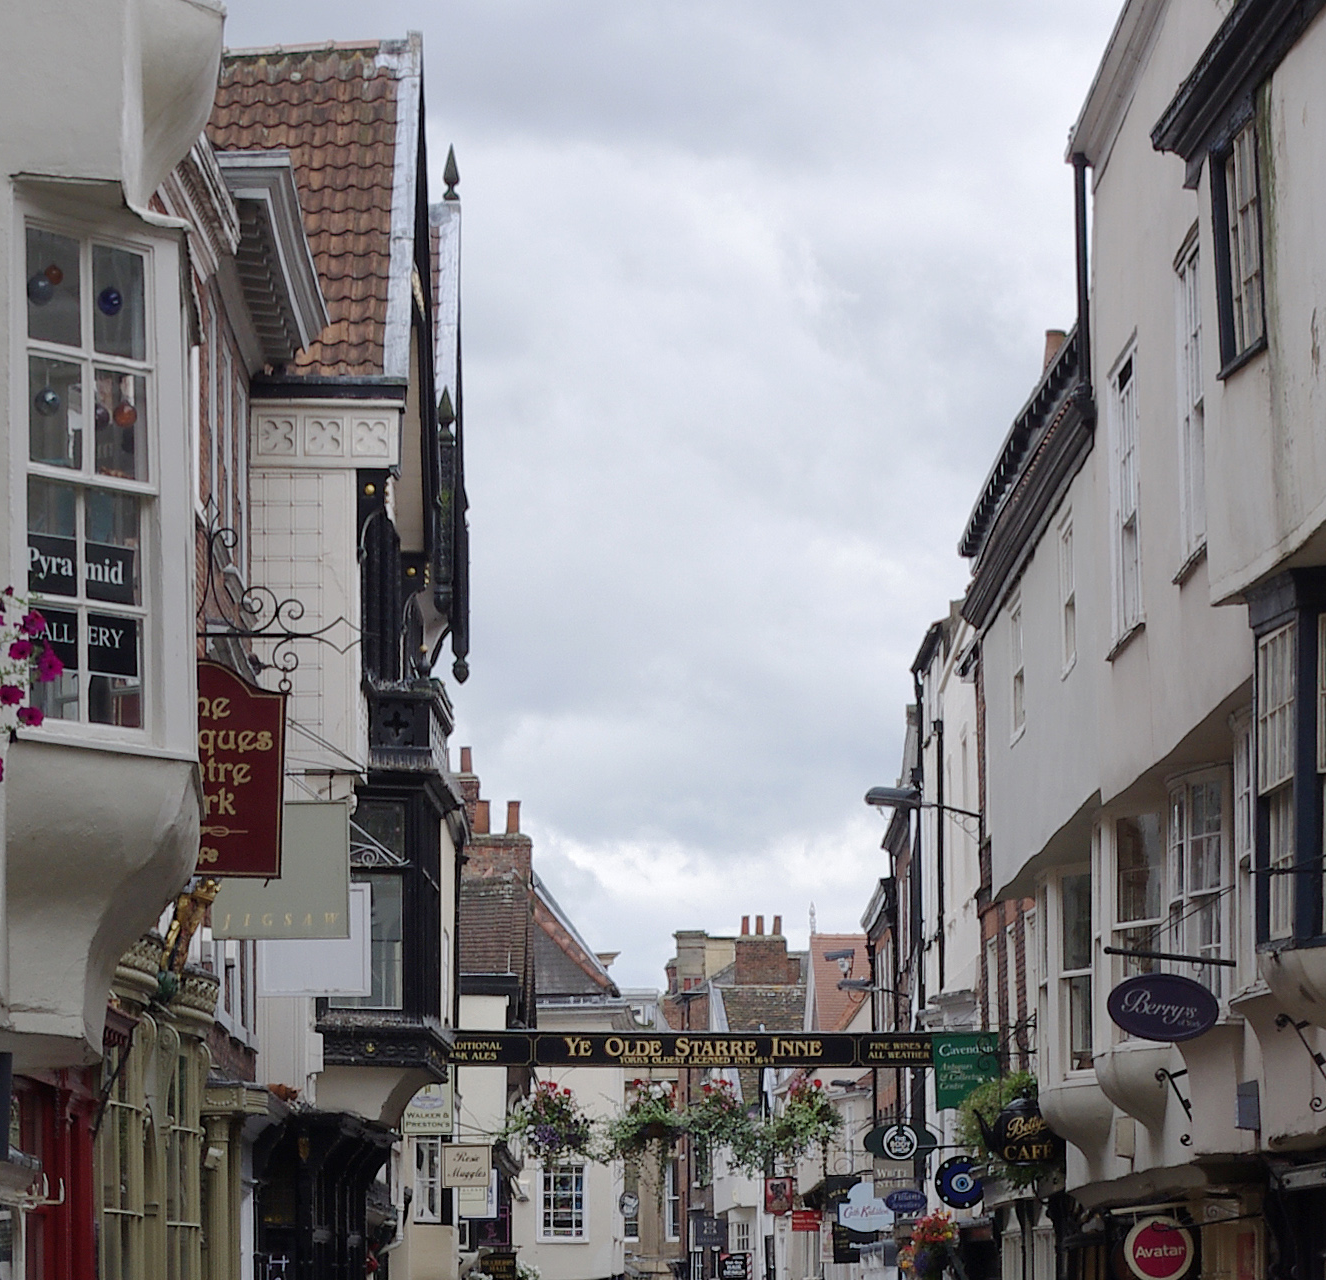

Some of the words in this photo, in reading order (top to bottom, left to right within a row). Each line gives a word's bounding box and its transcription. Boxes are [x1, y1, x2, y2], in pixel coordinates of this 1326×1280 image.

[28, 546, 124, 586] Pyramid
[198, 729, 274, 757] ques
[199, 761, 252, 787] tre
[204, 790, 237, 816] rk
[223, 912, 341, 931] JIGSAW
[448, 1051, 470, 1060] ASK
[472, 1051, 497, 1060] ALES
[451, 1042, 502, 1051] ADITIONAL
[604, 1037, 663, 1057] OLDE
[675, 1037, 758, 1057] STARRE
[771, 1036, 823, 1057] INNE
[867, 1051, 885, 1059] ALL
[893, 1042, 921, 1050] WINES
[1135, 1243, 1185, 1259] Avatar
